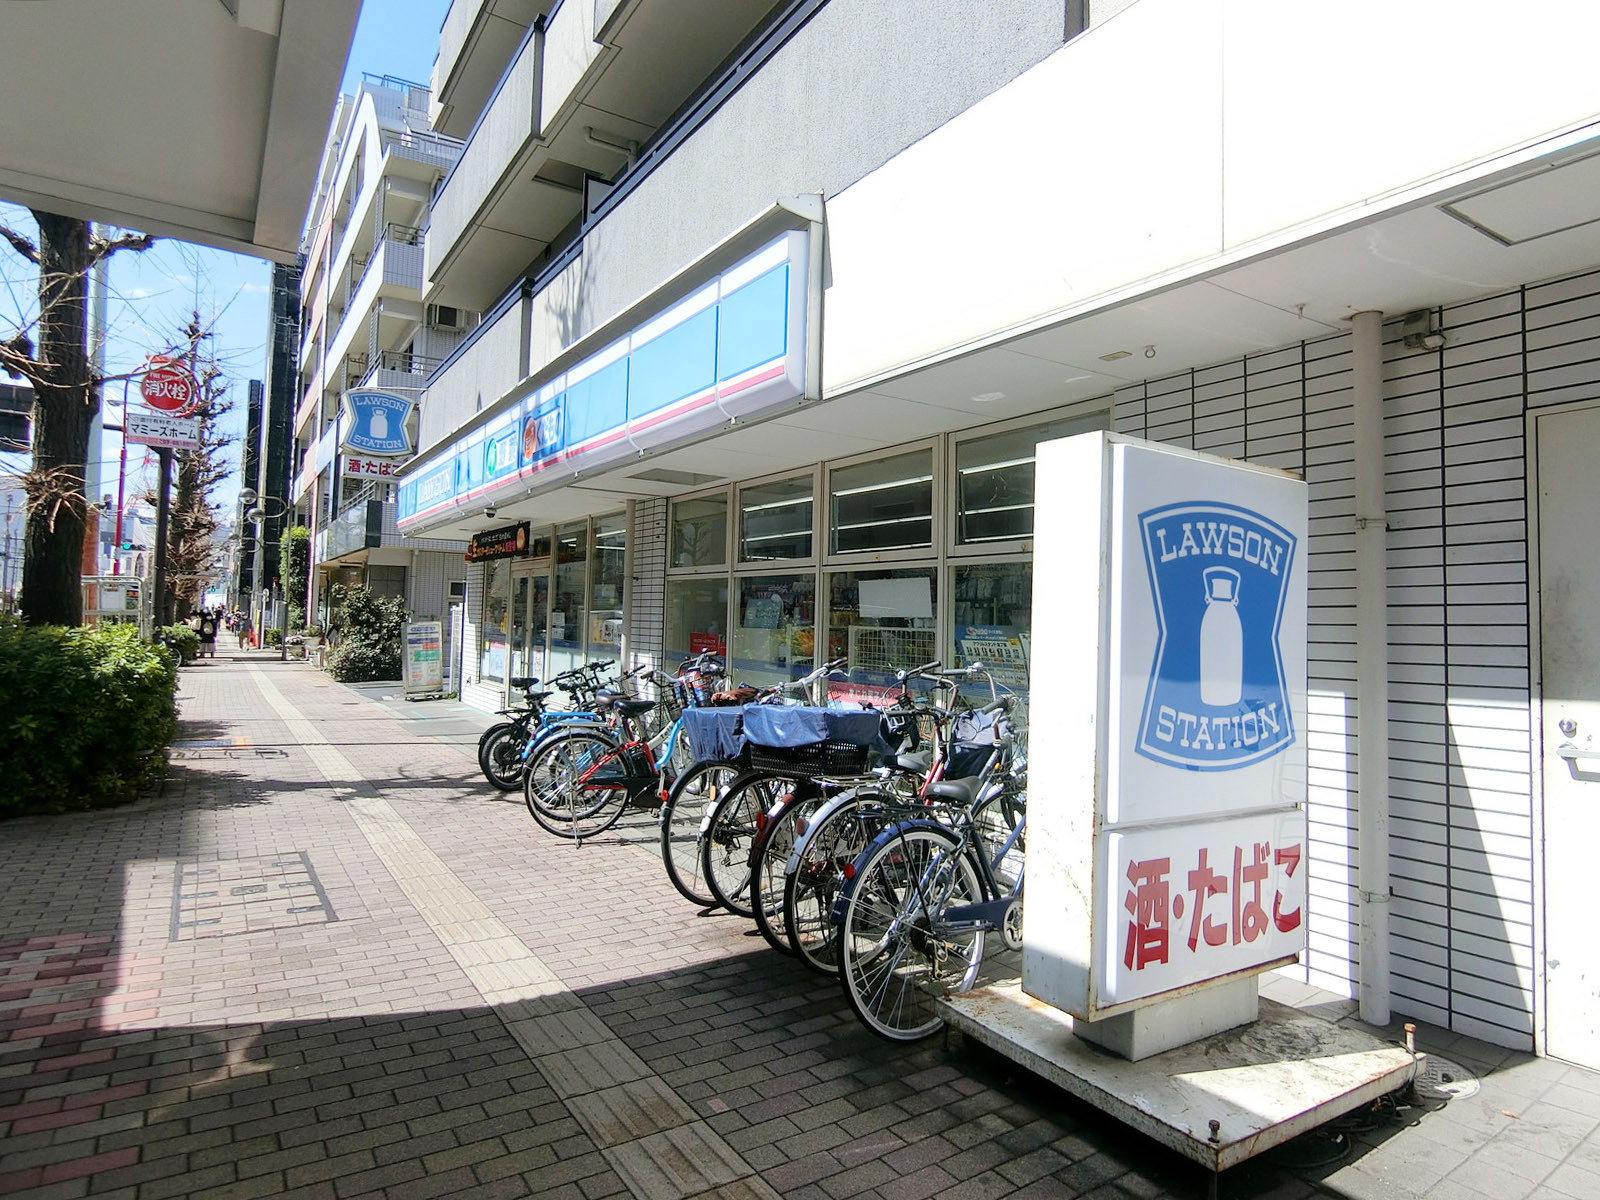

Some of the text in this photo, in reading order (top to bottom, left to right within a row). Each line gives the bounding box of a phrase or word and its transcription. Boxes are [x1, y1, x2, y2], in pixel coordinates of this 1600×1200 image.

[145, 380, 187, 400] 消火栓
[354, 396, 405, 412] LAWSON
[131, 423, 197, 439] マミーズホーム
[353, 435, 402, 449] STATION
[1156, 522, 1283, 576] LAWSON
[1155, 702, 1280, 750] STATION
[1124, 841, 1301, 971] 酒・たばこ
